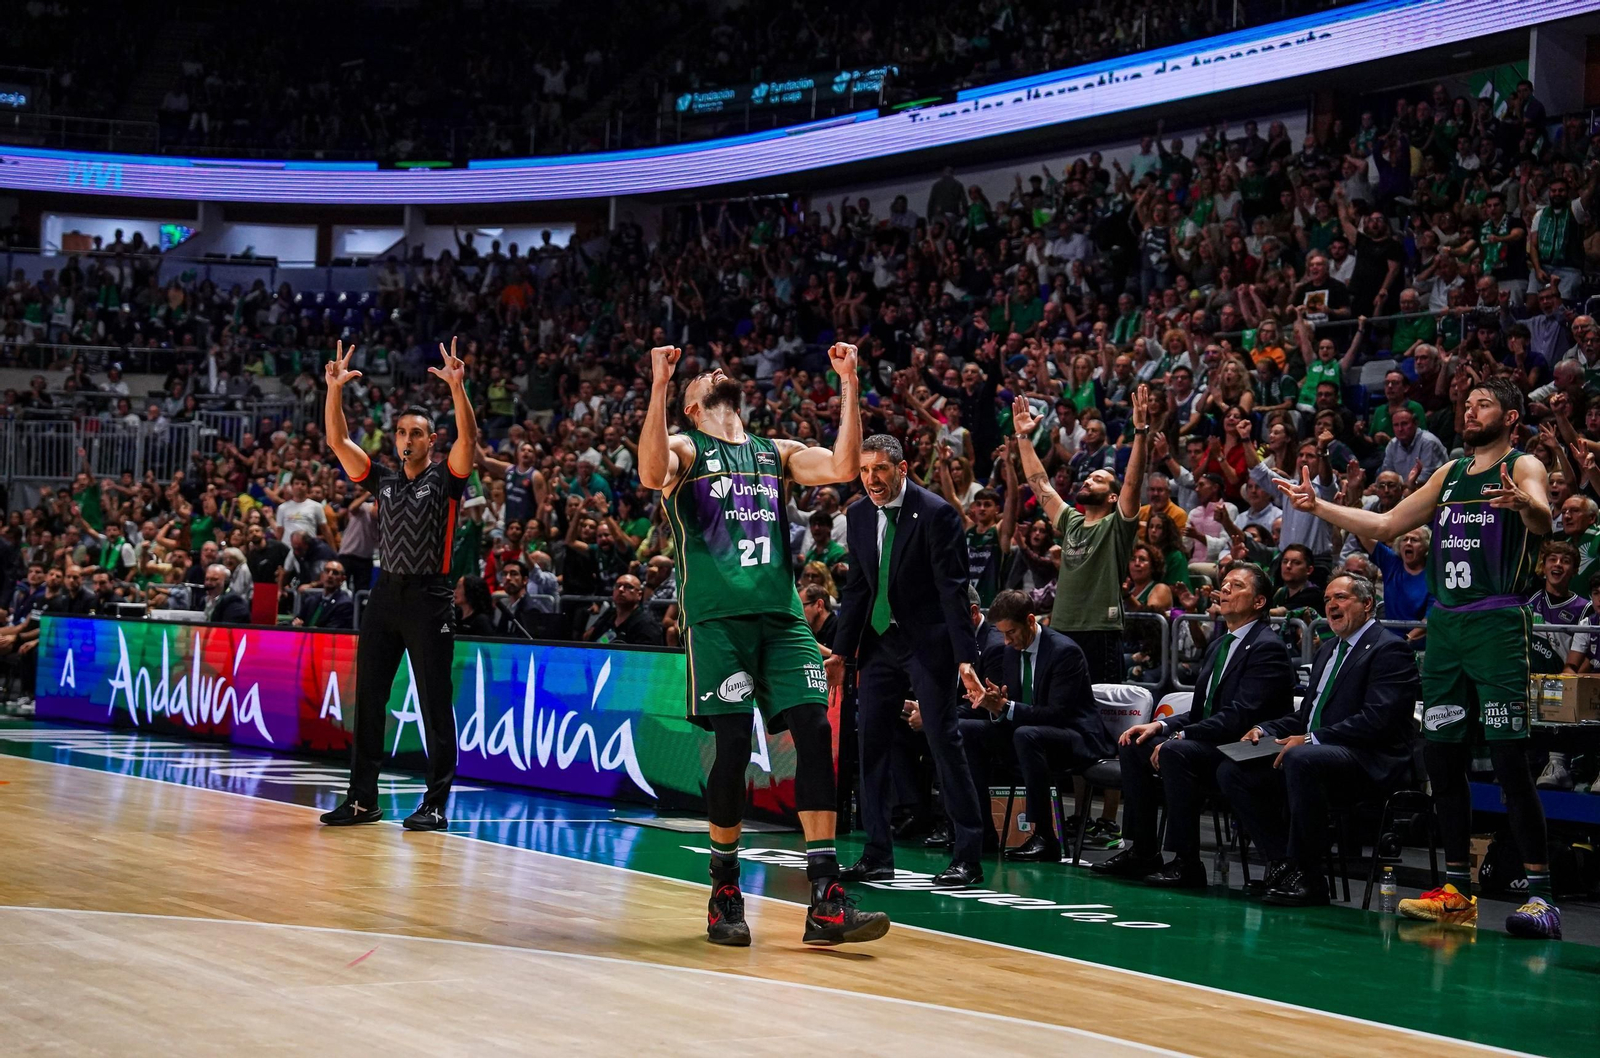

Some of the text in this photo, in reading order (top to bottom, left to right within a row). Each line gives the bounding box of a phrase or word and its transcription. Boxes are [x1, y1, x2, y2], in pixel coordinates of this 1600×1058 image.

[733, 483, 779, 499] Unicaja
[1451, 511, 1495, 526] Unicaja
[738, 536, 771, 567] 27
[1445, 561, 1471, 589] 33
[108, 626, 274, 743] Andalucía
[391, 648, 658, 798] Adalucía
[1426, 707, 1464, 721] amadesa
[1486, 715, 1509, 728] laga
